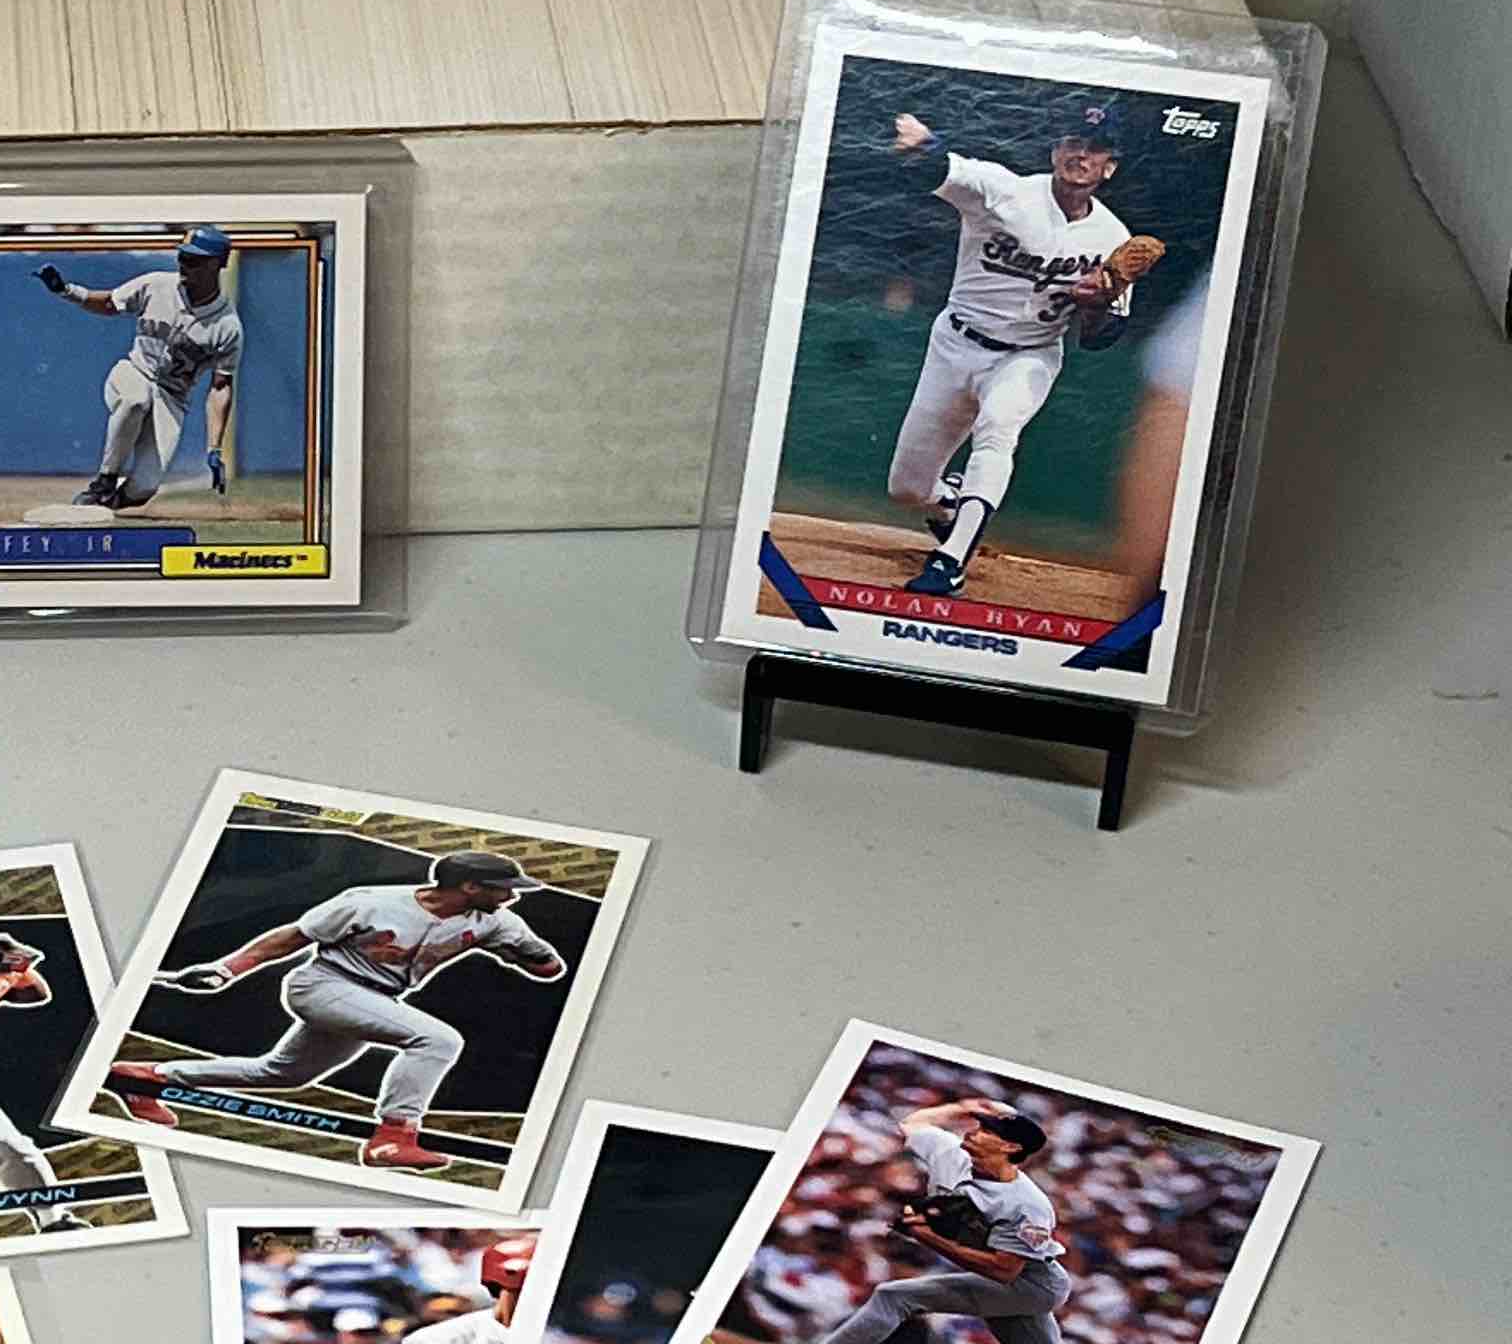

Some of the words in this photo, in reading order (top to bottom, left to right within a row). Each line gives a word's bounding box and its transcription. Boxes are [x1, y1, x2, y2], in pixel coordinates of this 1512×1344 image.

[193, 550, 294, 570] Mariners
[829, 586, 953, 618] NOLAN
[986, 608, 1083, 639] RYAN
[882, 619, 1019, 656] RANGERS
[161, 1086, 244, 1111] OZZIE
[247, 1103, 341, 1131] SMITH
